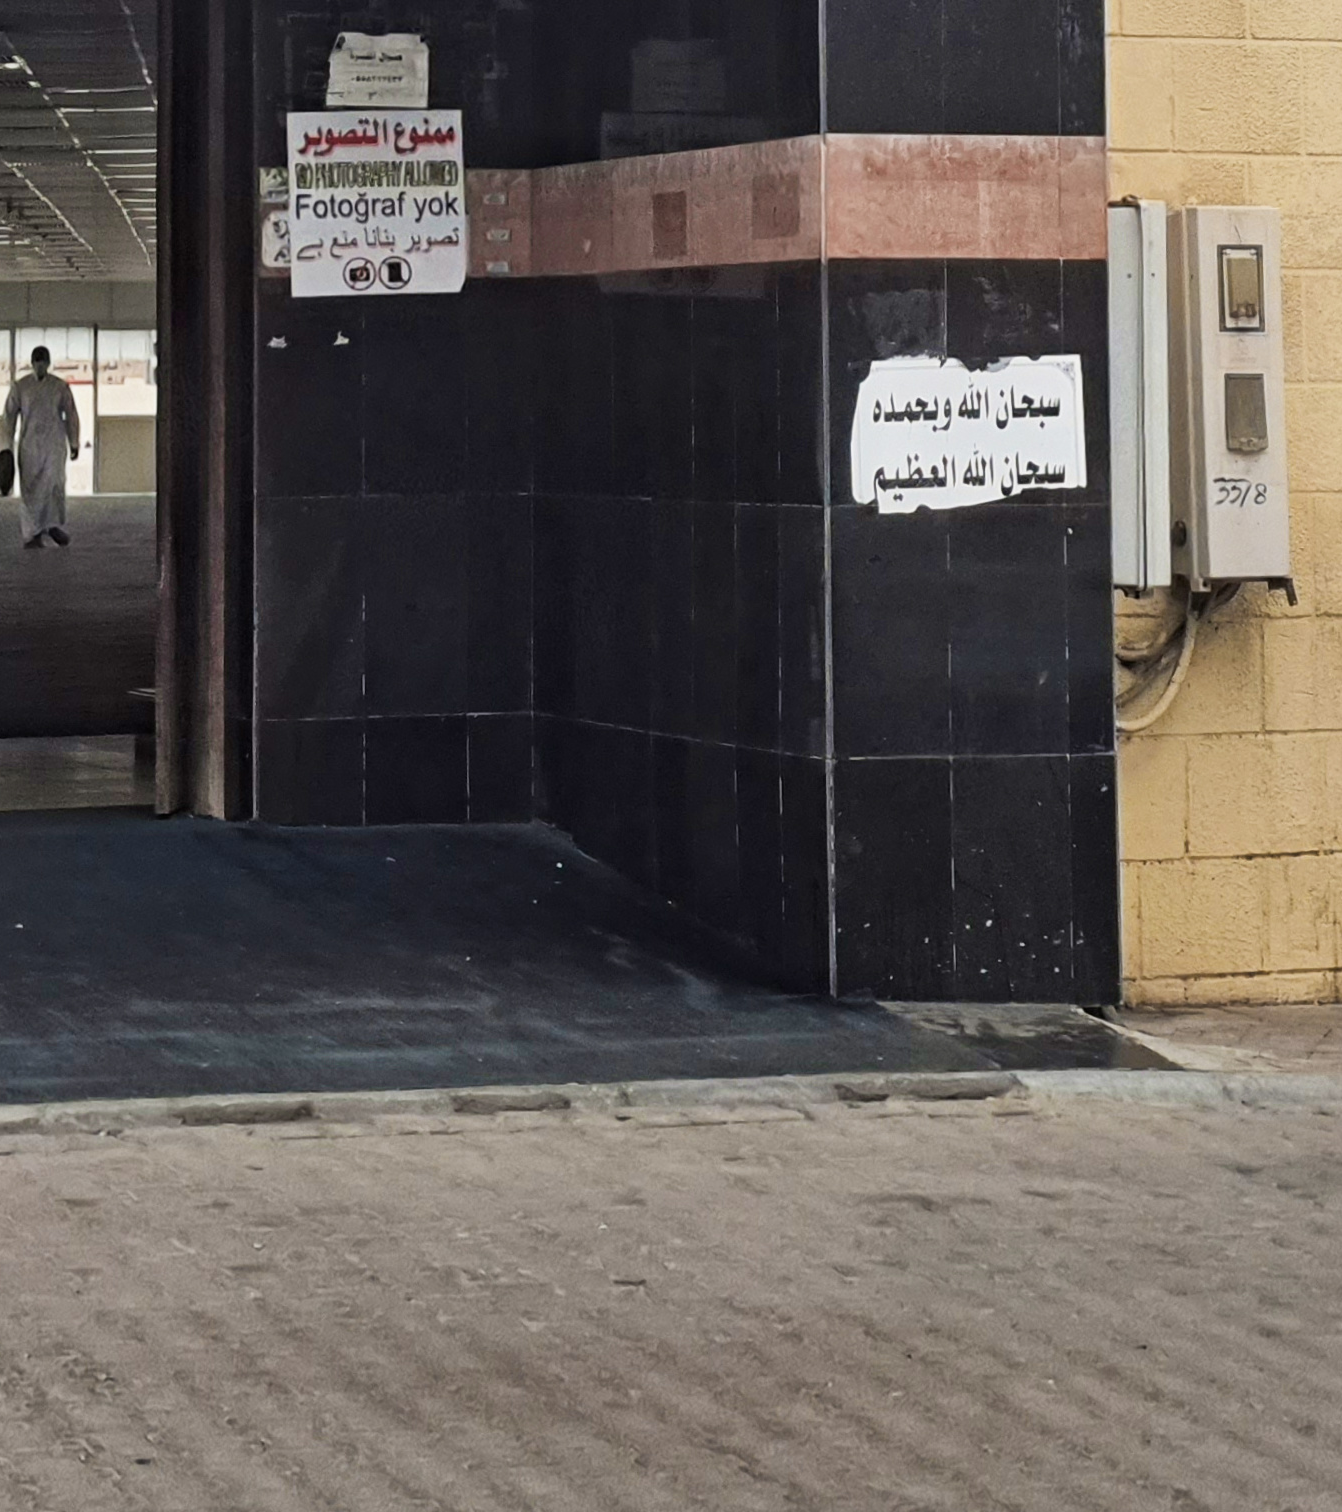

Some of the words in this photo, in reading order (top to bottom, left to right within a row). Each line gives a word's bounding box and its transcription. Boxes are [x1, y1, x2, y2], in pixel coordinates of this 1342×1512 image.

[298, 118, 388, 156] التصوير
[393, 118, 455, 154] ممنوع
[315, 161, 403, 189] PHOTOGRAPHY
[404, 160, 458, 187] ALLOWED
[296, 192, 407, 223] Fotoğraf
[413, 191, 459, 223] yok
[329, 230, 358, 258] منع
[873, 392, 952, 433] وبحمده
[958, 376, 989, 420] الله
[996, 385, 1061, 430] سبحان
[874, 453, 956, 502] العظيم
[963, 442, 994, 487] الله
[1001, 451, 1066, 497] سبحان
